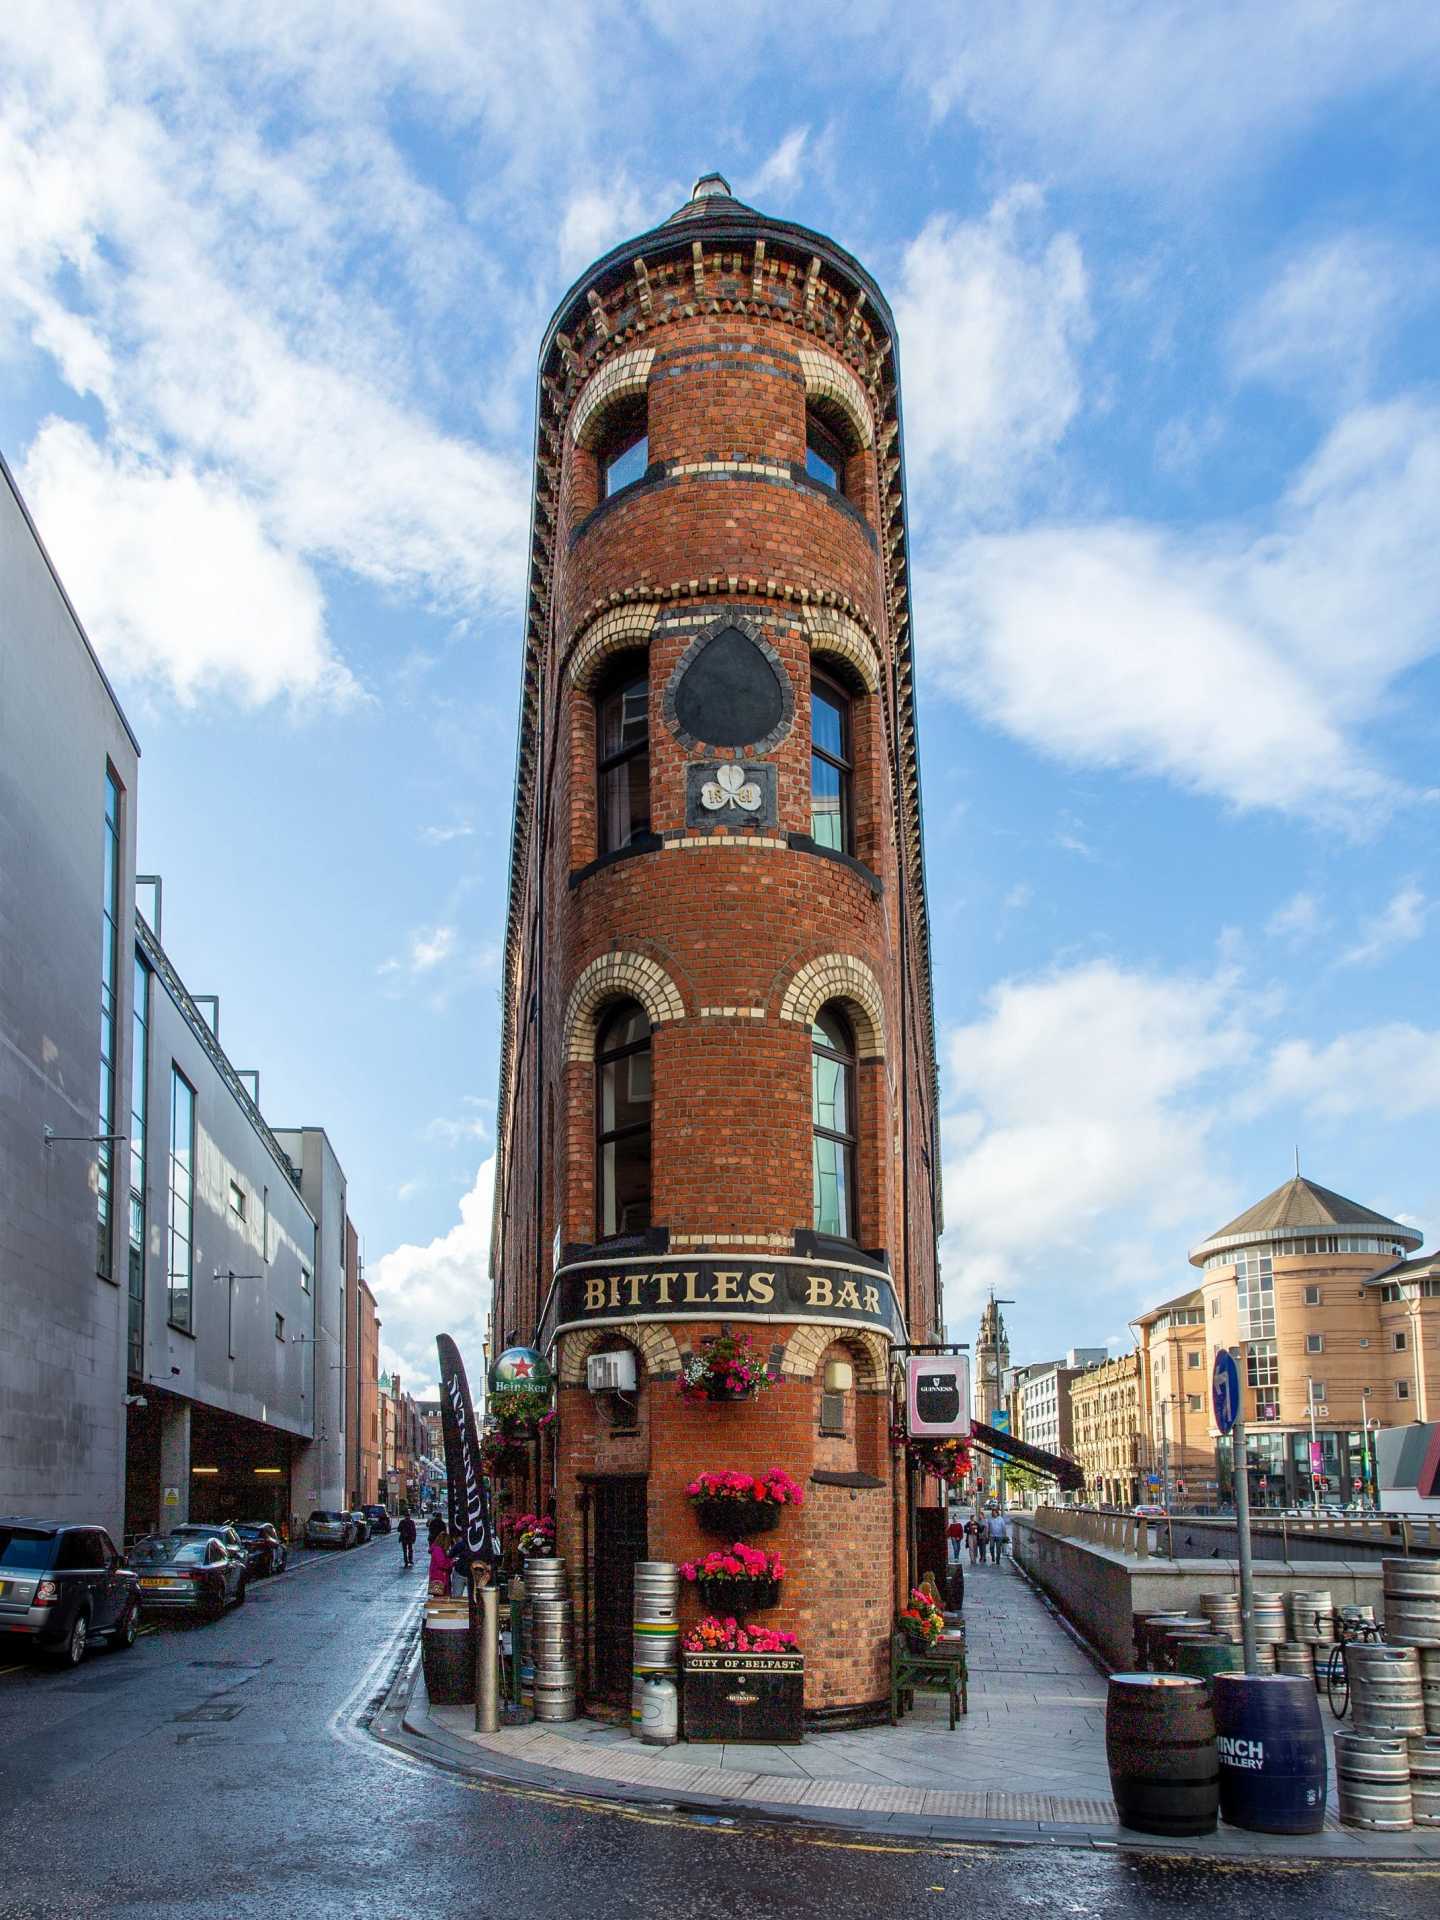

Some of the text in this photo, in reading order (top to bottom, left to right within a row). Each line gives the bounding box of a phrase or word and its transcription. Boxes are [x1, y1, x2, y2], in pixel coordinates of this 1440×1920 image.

[584, 1272, 882, 1315] BITTLES BAR
[1304, 1405, 1329, 1417] AIB
[691, 1659, 796, 1669] CITY OF BELFAST
